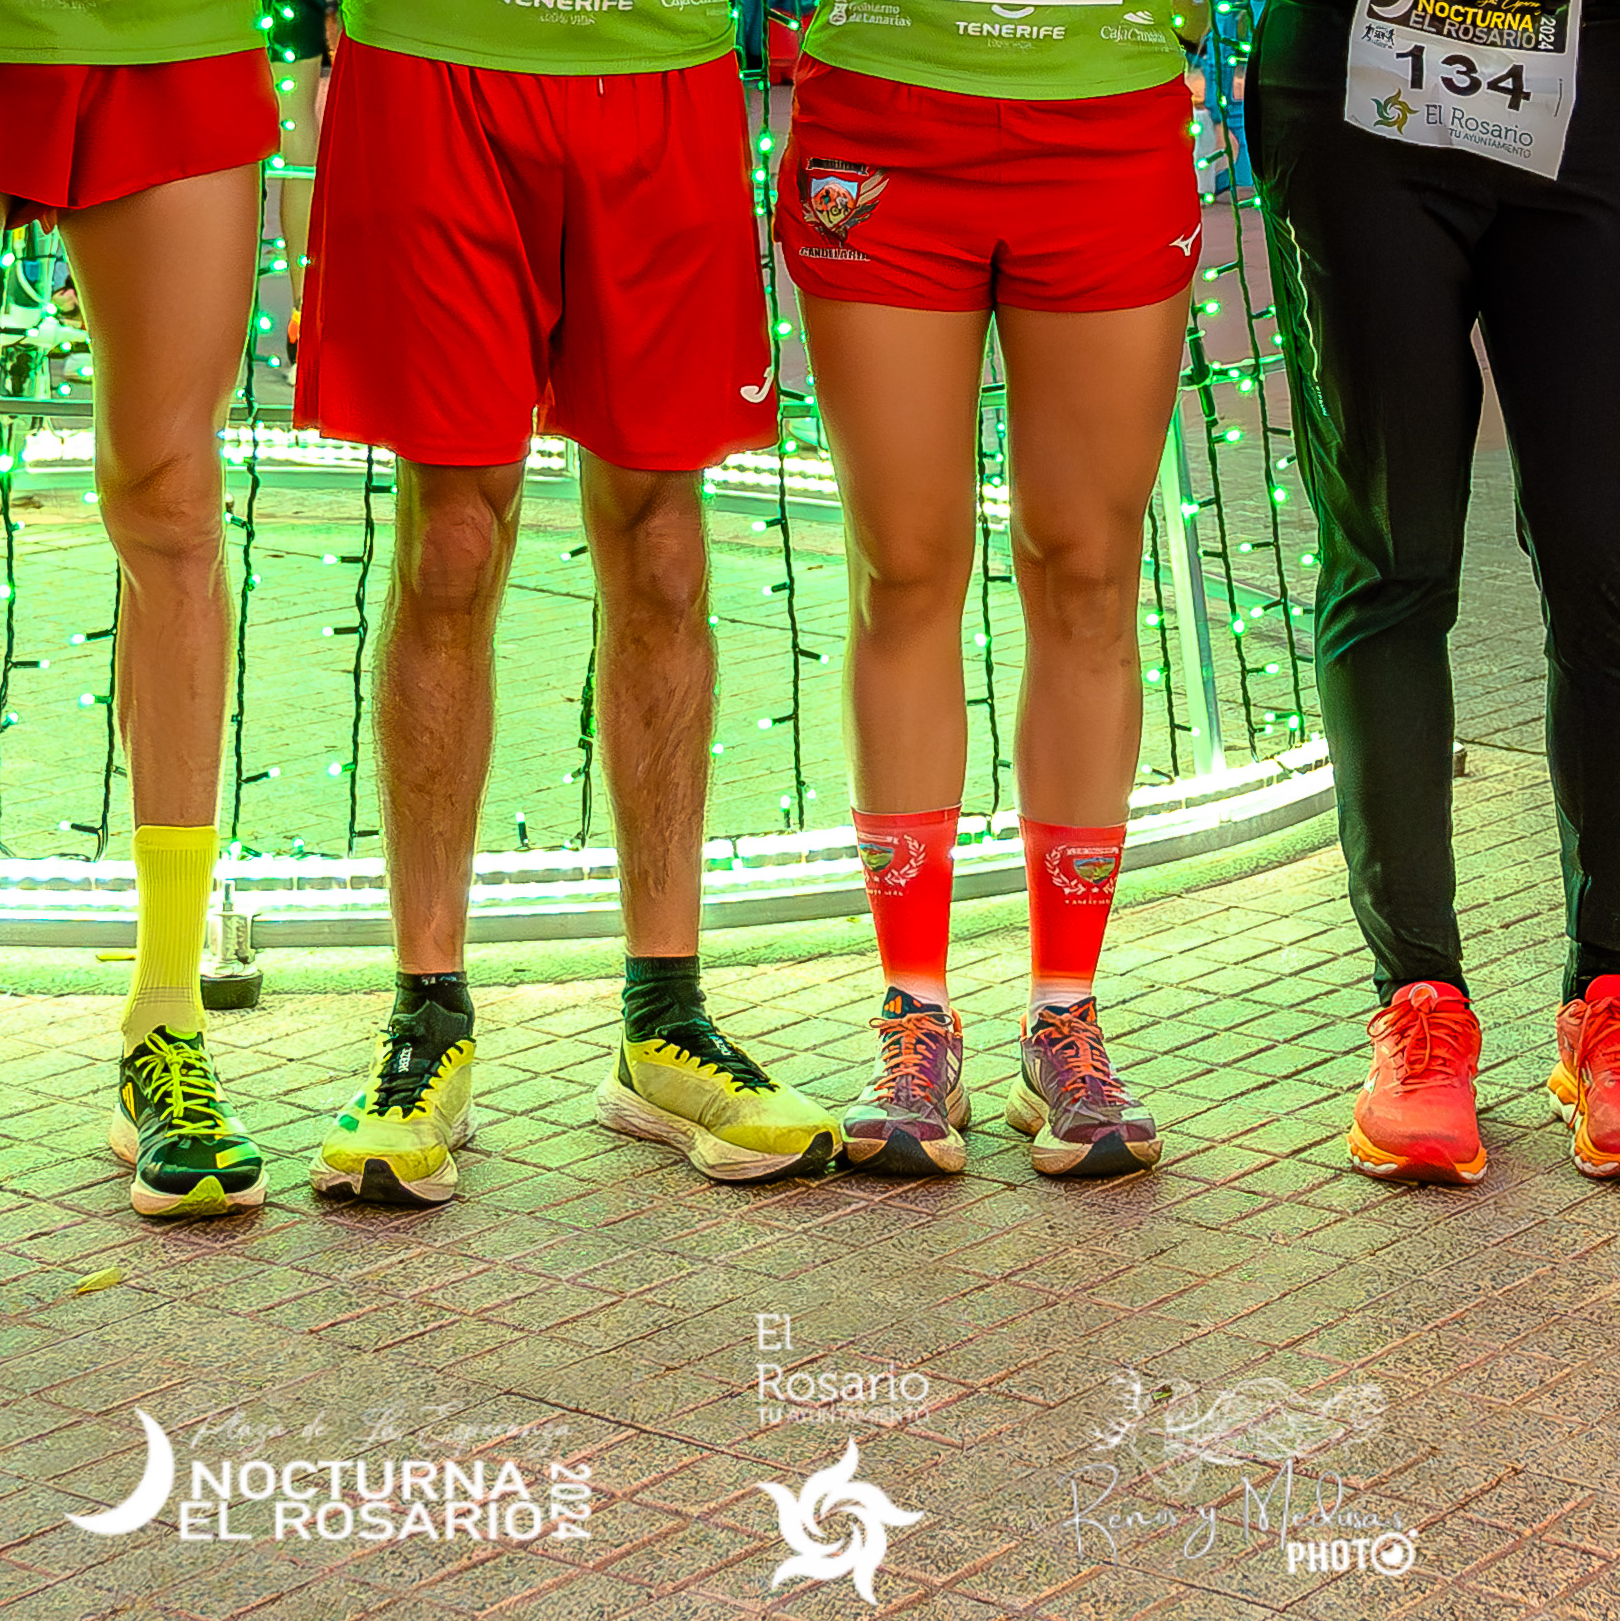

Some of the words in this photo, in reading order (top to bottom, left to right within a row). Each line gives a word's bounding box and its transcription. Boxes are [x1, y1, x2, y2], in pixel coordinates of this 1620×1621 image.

[955, 21, 1066, 41] TENERIFE
[1410, 10, 1436, 31] EL
[1443, 19, 1535, 49] ROSARIO
[1538, 15, 1556, 50] 2024
[1396, 44, 1531, 111] 134
[1425, 104, 1442, 124] El
[1451, 106, 1533, 147] Rosario
[1450, 129, 1461, 138] TU
